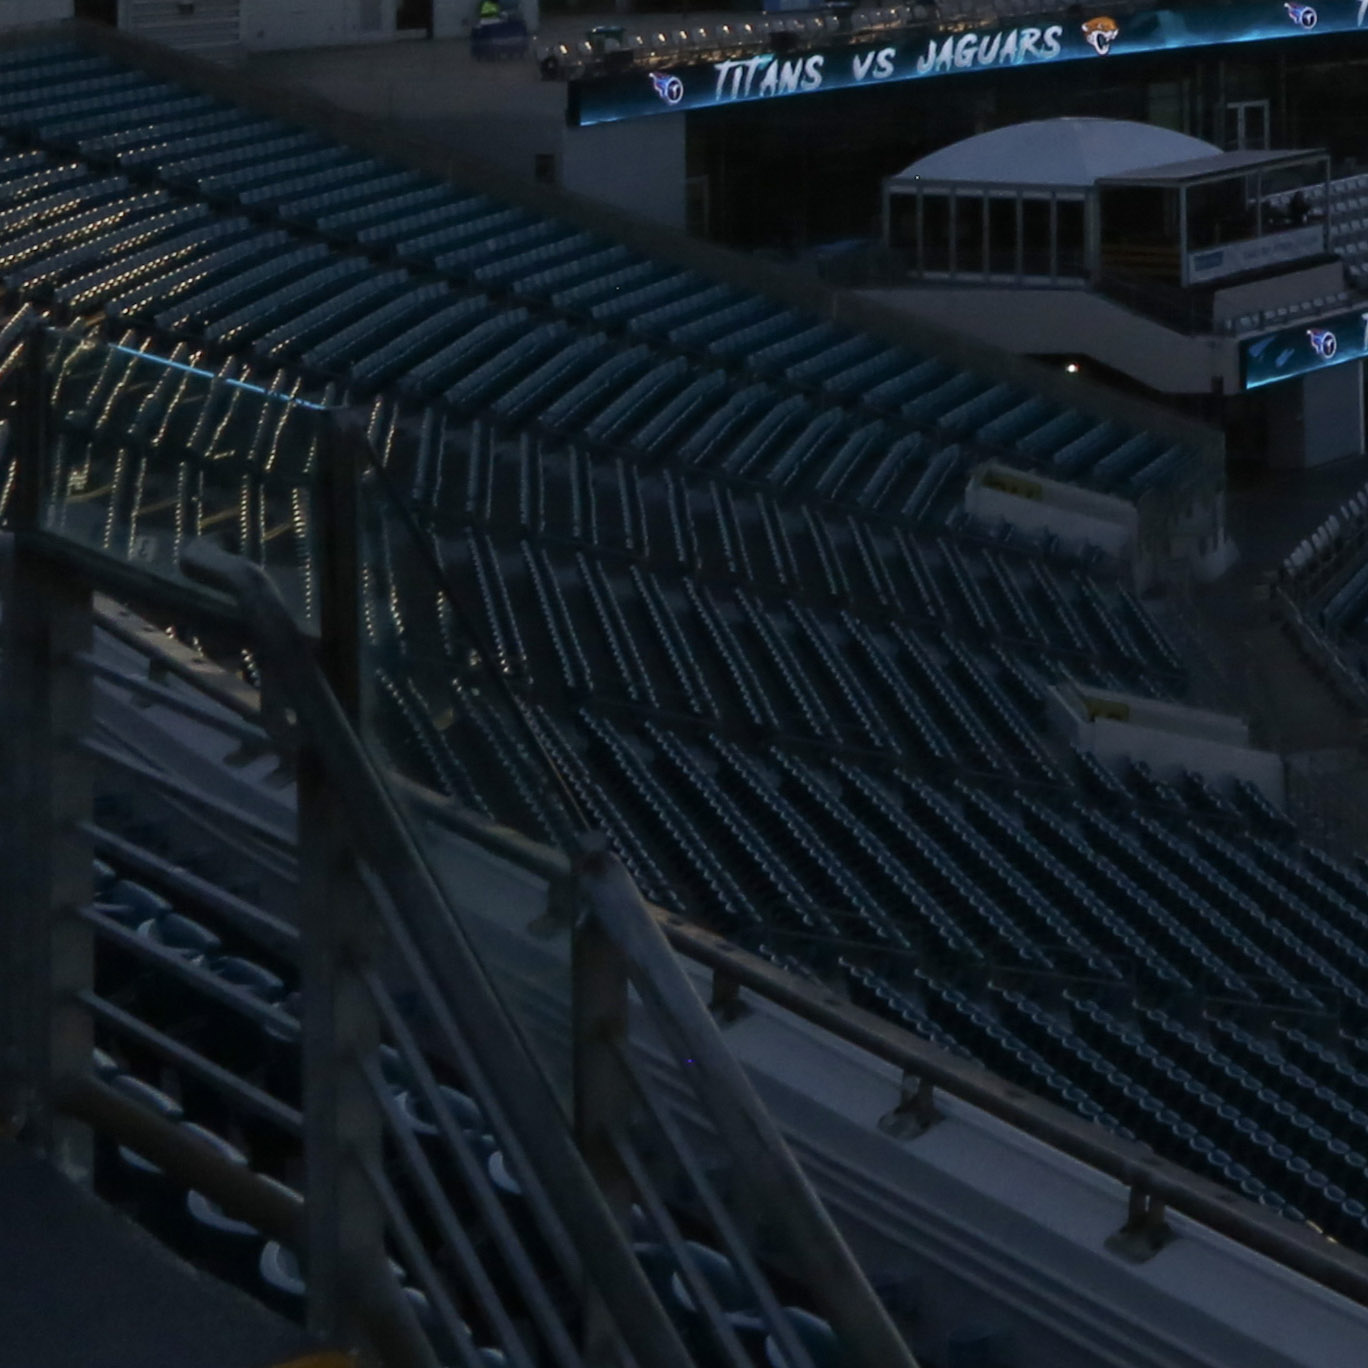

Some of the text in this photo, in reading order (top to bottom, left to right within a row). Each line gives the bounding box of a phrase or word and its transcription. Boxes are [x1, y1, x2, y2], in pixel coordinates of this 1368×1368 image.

[714, 26, 1063, 99] TITANS VS JAGUARS
